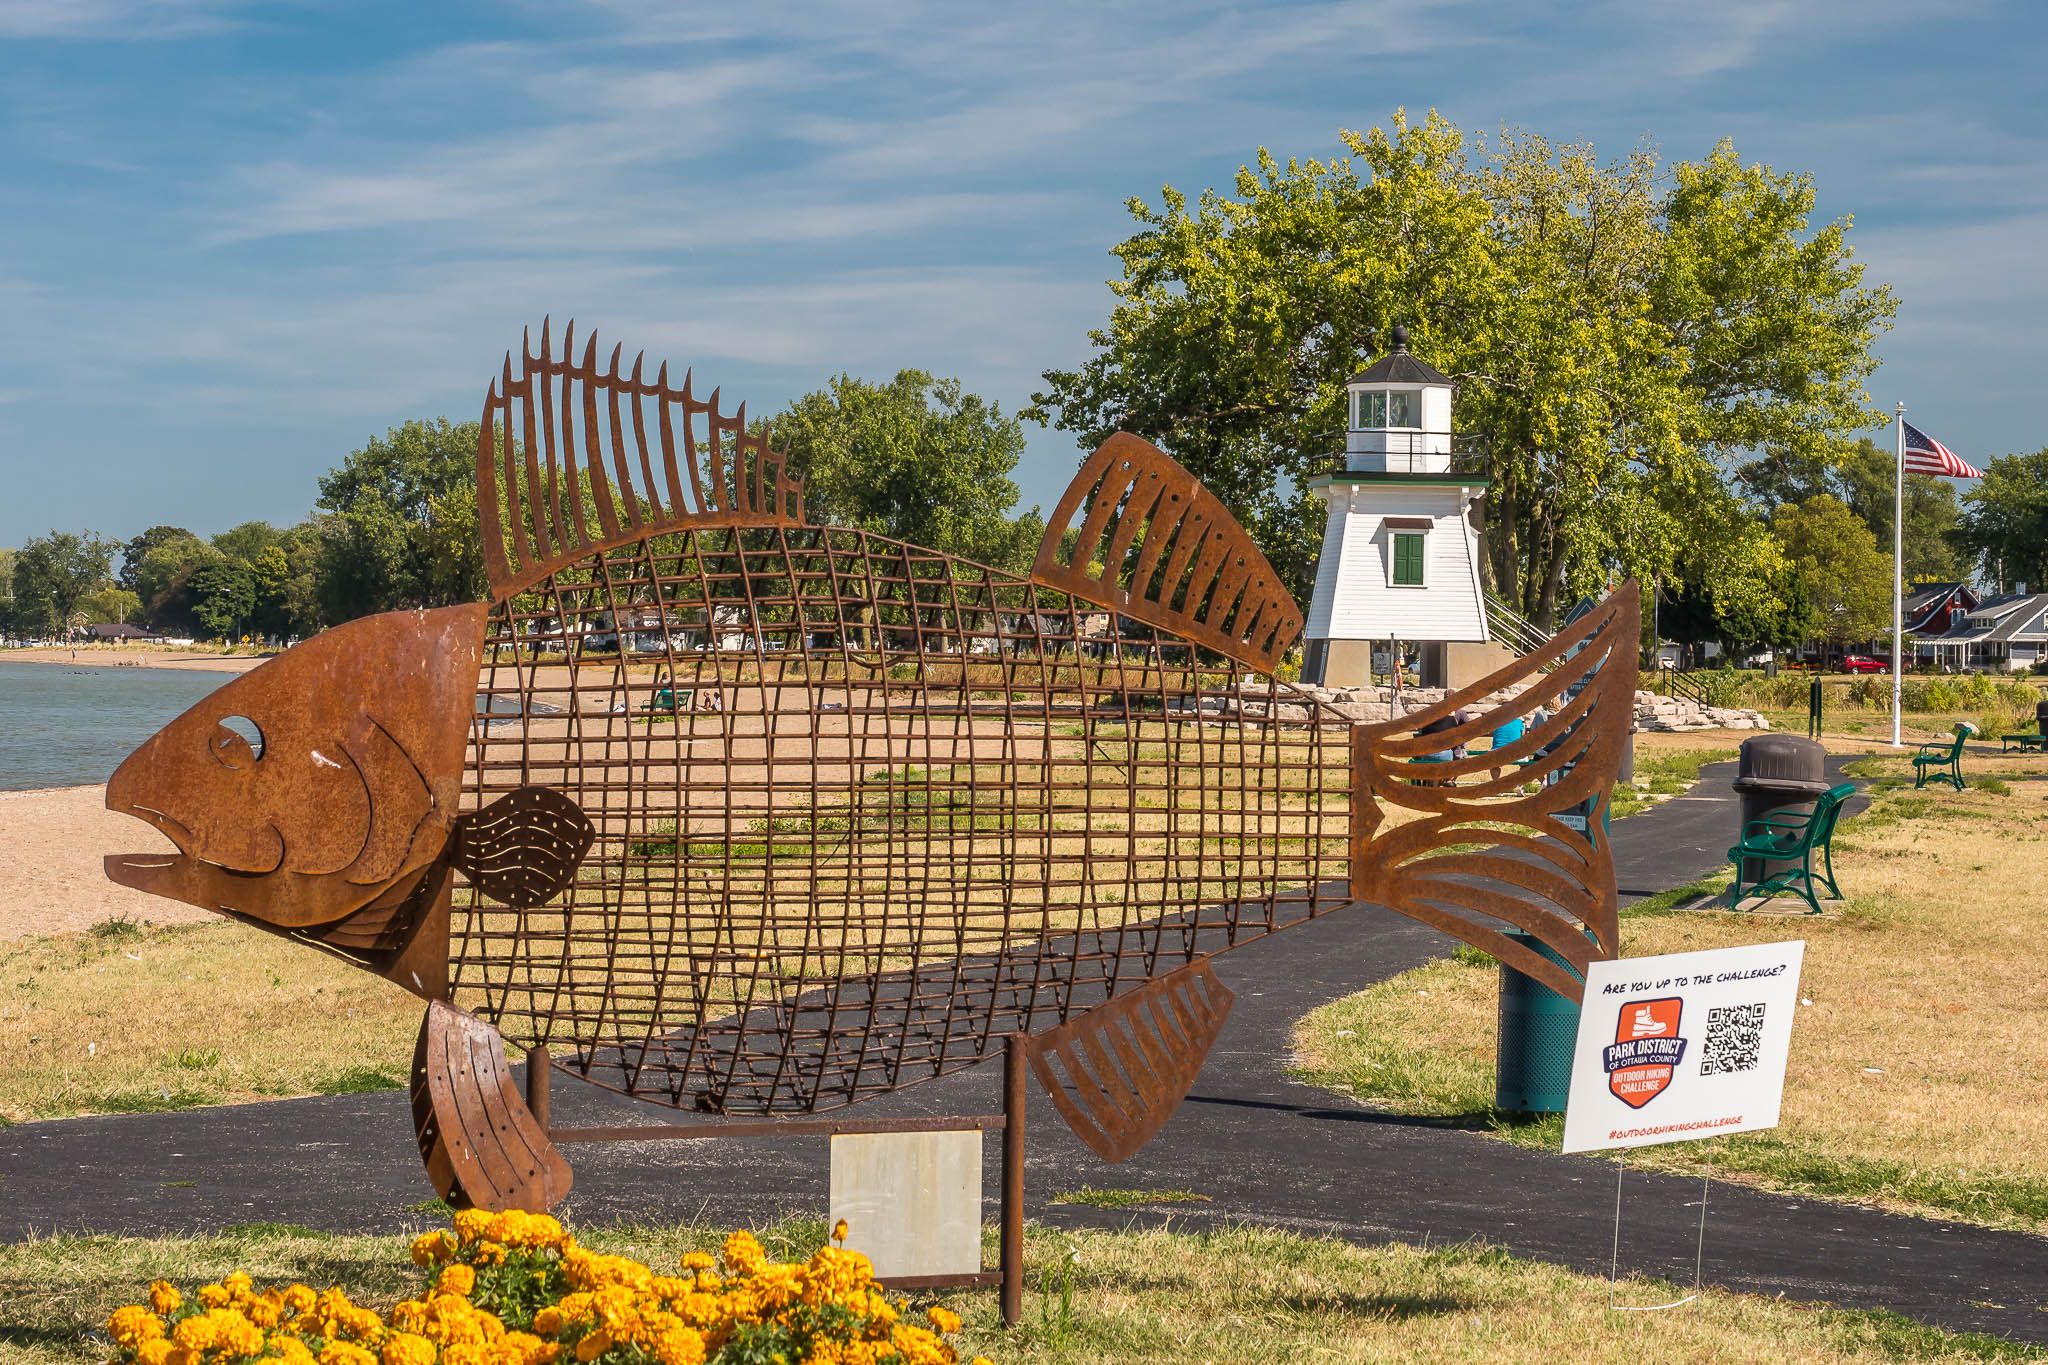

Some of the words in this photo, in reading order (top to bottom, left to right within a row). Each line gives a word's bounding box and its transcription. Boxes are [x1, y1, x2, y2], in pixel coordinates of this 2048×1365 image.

[1603, 983, 1626, 994] ARE
[1630, 981, 1652, 992] YOU
[1656, 978, 1671, 989] UP
[1675, 977, 1688, 987] TO
[1693, 974, 1713, 985] THE
[1716, 964, 1787, 982] CHALLENGE?
[1608, 1041, 1636, 1062] PARK
[1637, 1038, 1683, 1055] DISTRICT
[1609, 1061, 1619, 1070] OF
[1621, 1056, 1647, 1067] OTTAWA
[1649, 1055, 1678, 1063] COUNTY
[1614, 1070, 1645, 1083] OUTDOOR
[1646, 1068, 1670, 1080] HIKING
[1620, 1079, 1660, 1094] CHALLENGE
[1608, 1115, 1743, 1140] #OUTDOORHIKINGCHALLENGE
